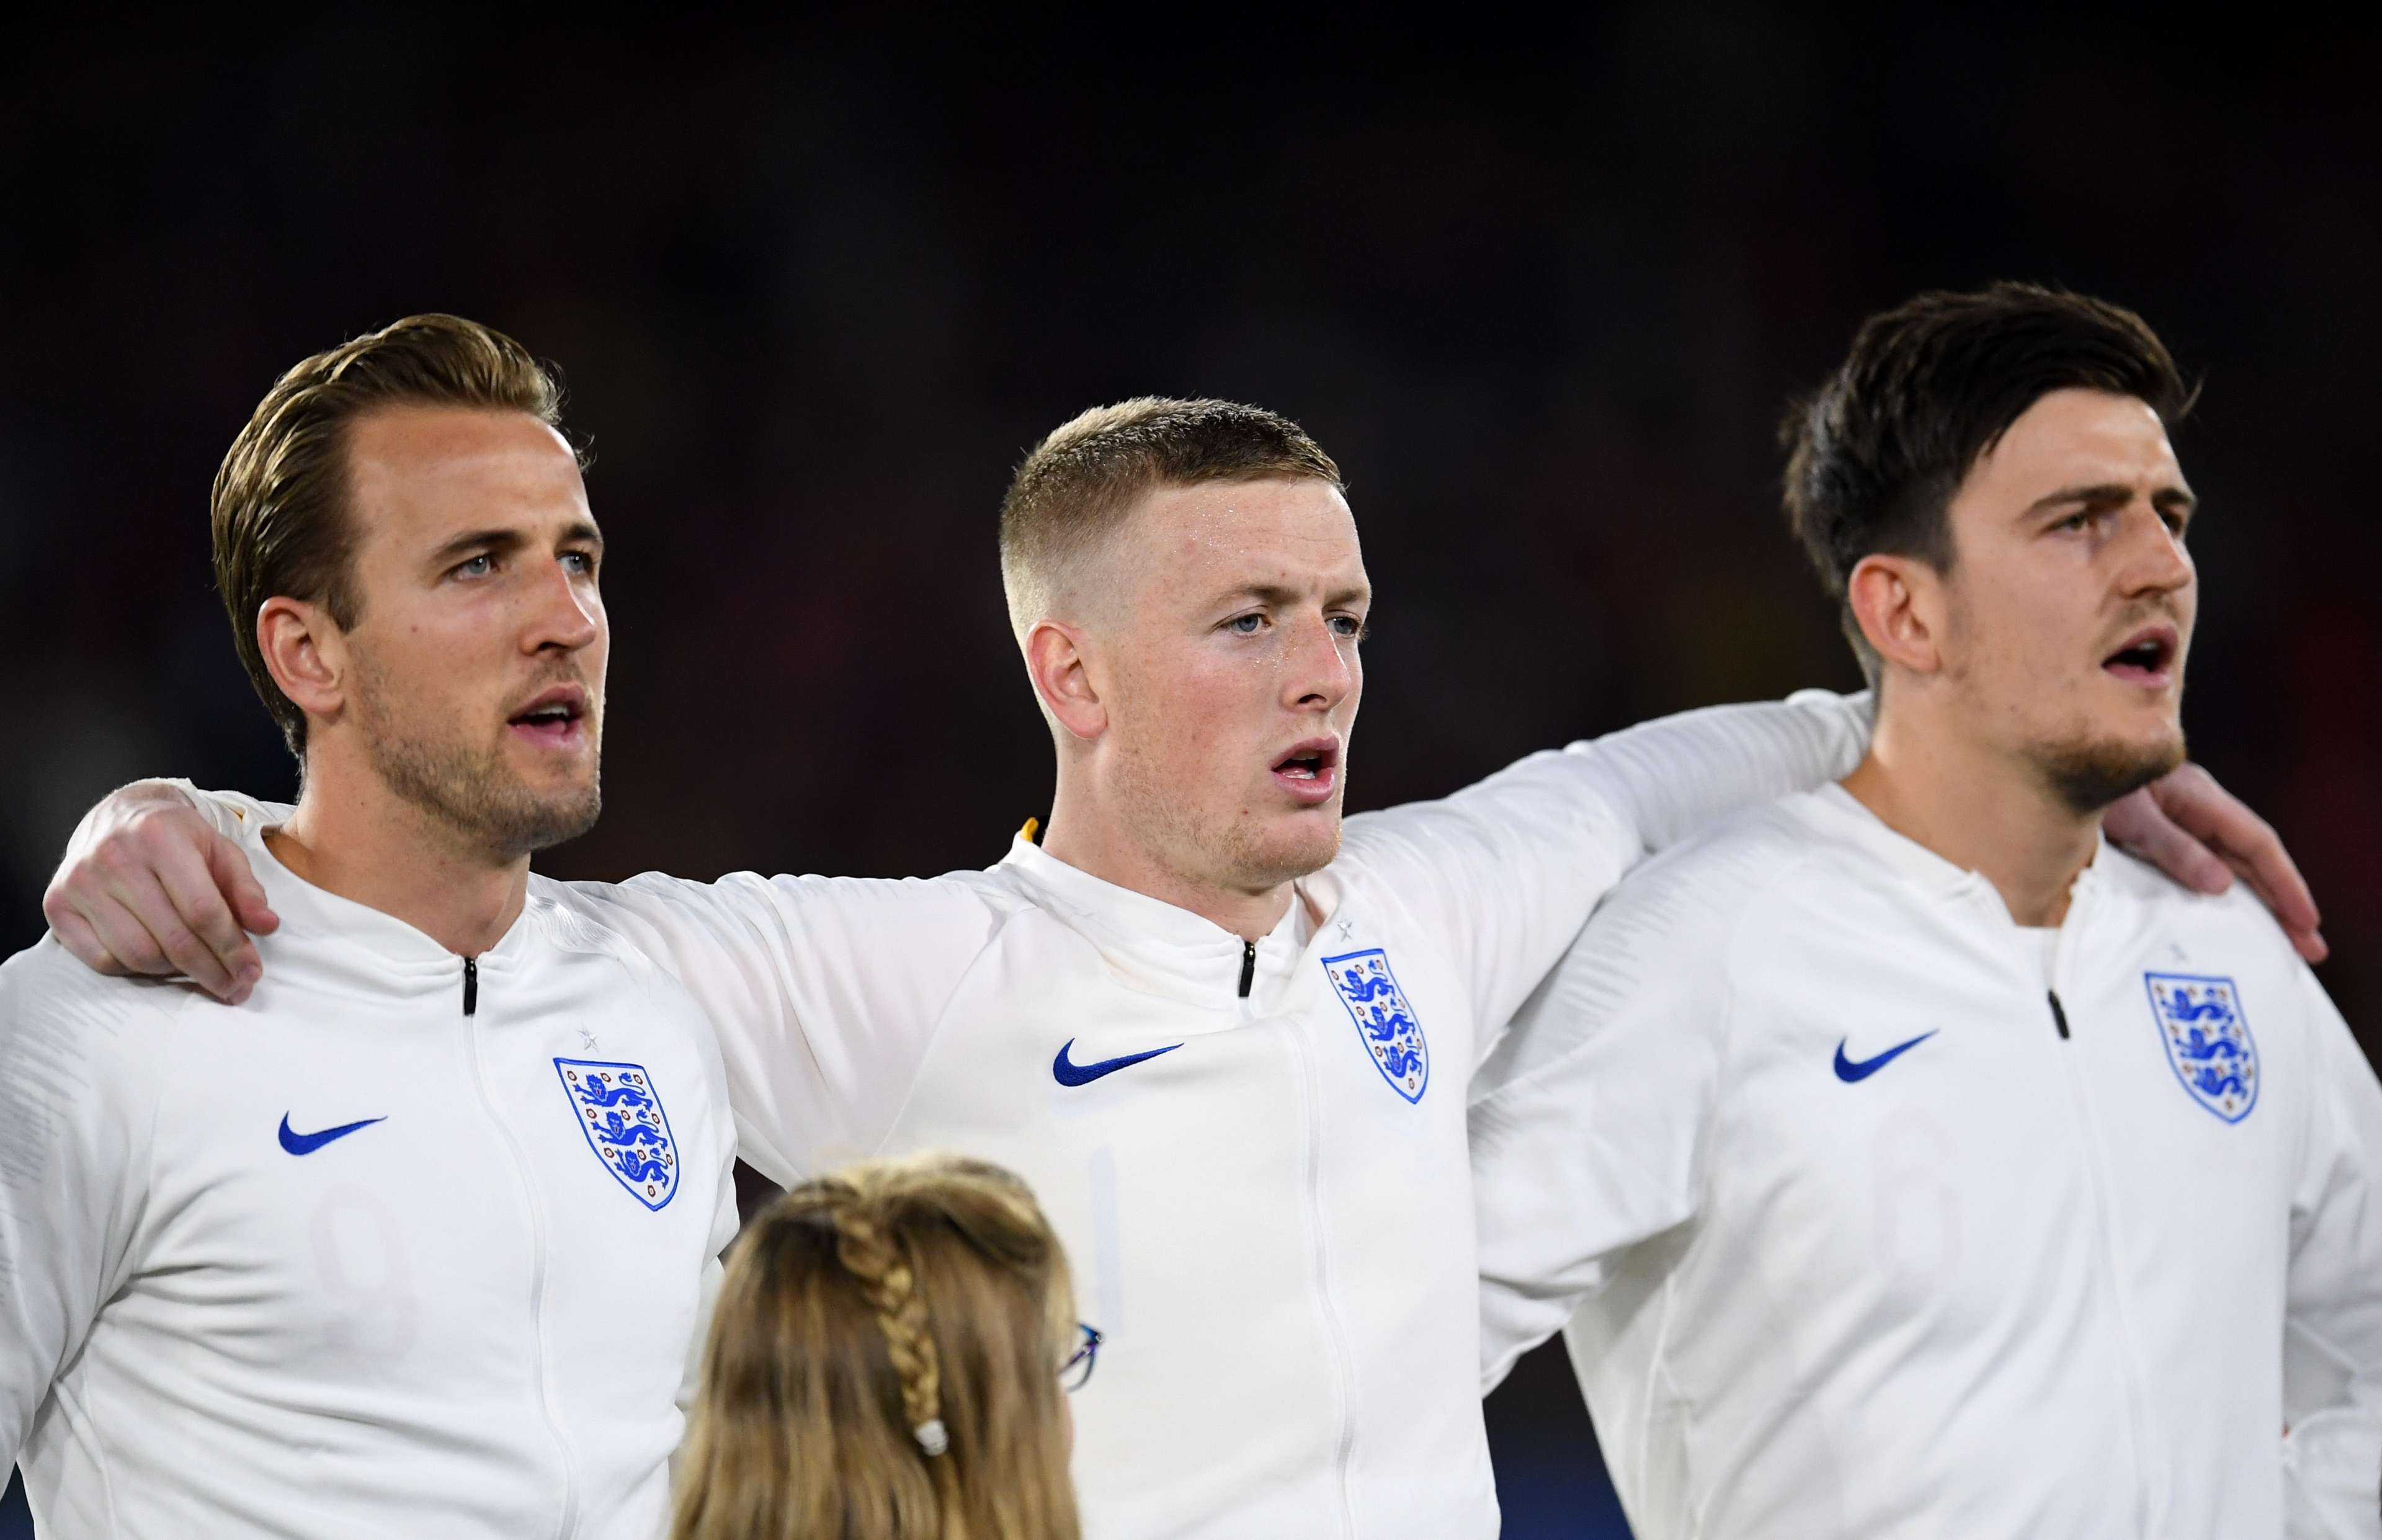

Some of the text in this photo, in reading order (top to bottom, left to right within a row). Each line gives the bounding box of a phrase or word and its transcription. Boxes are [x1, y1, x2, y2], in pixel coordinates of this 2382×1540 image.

[310, 1183, 418, 1363] 9
[1090, 1147, 1122, 1336] 1
[1871, 1104, 1963, 1299] 6
